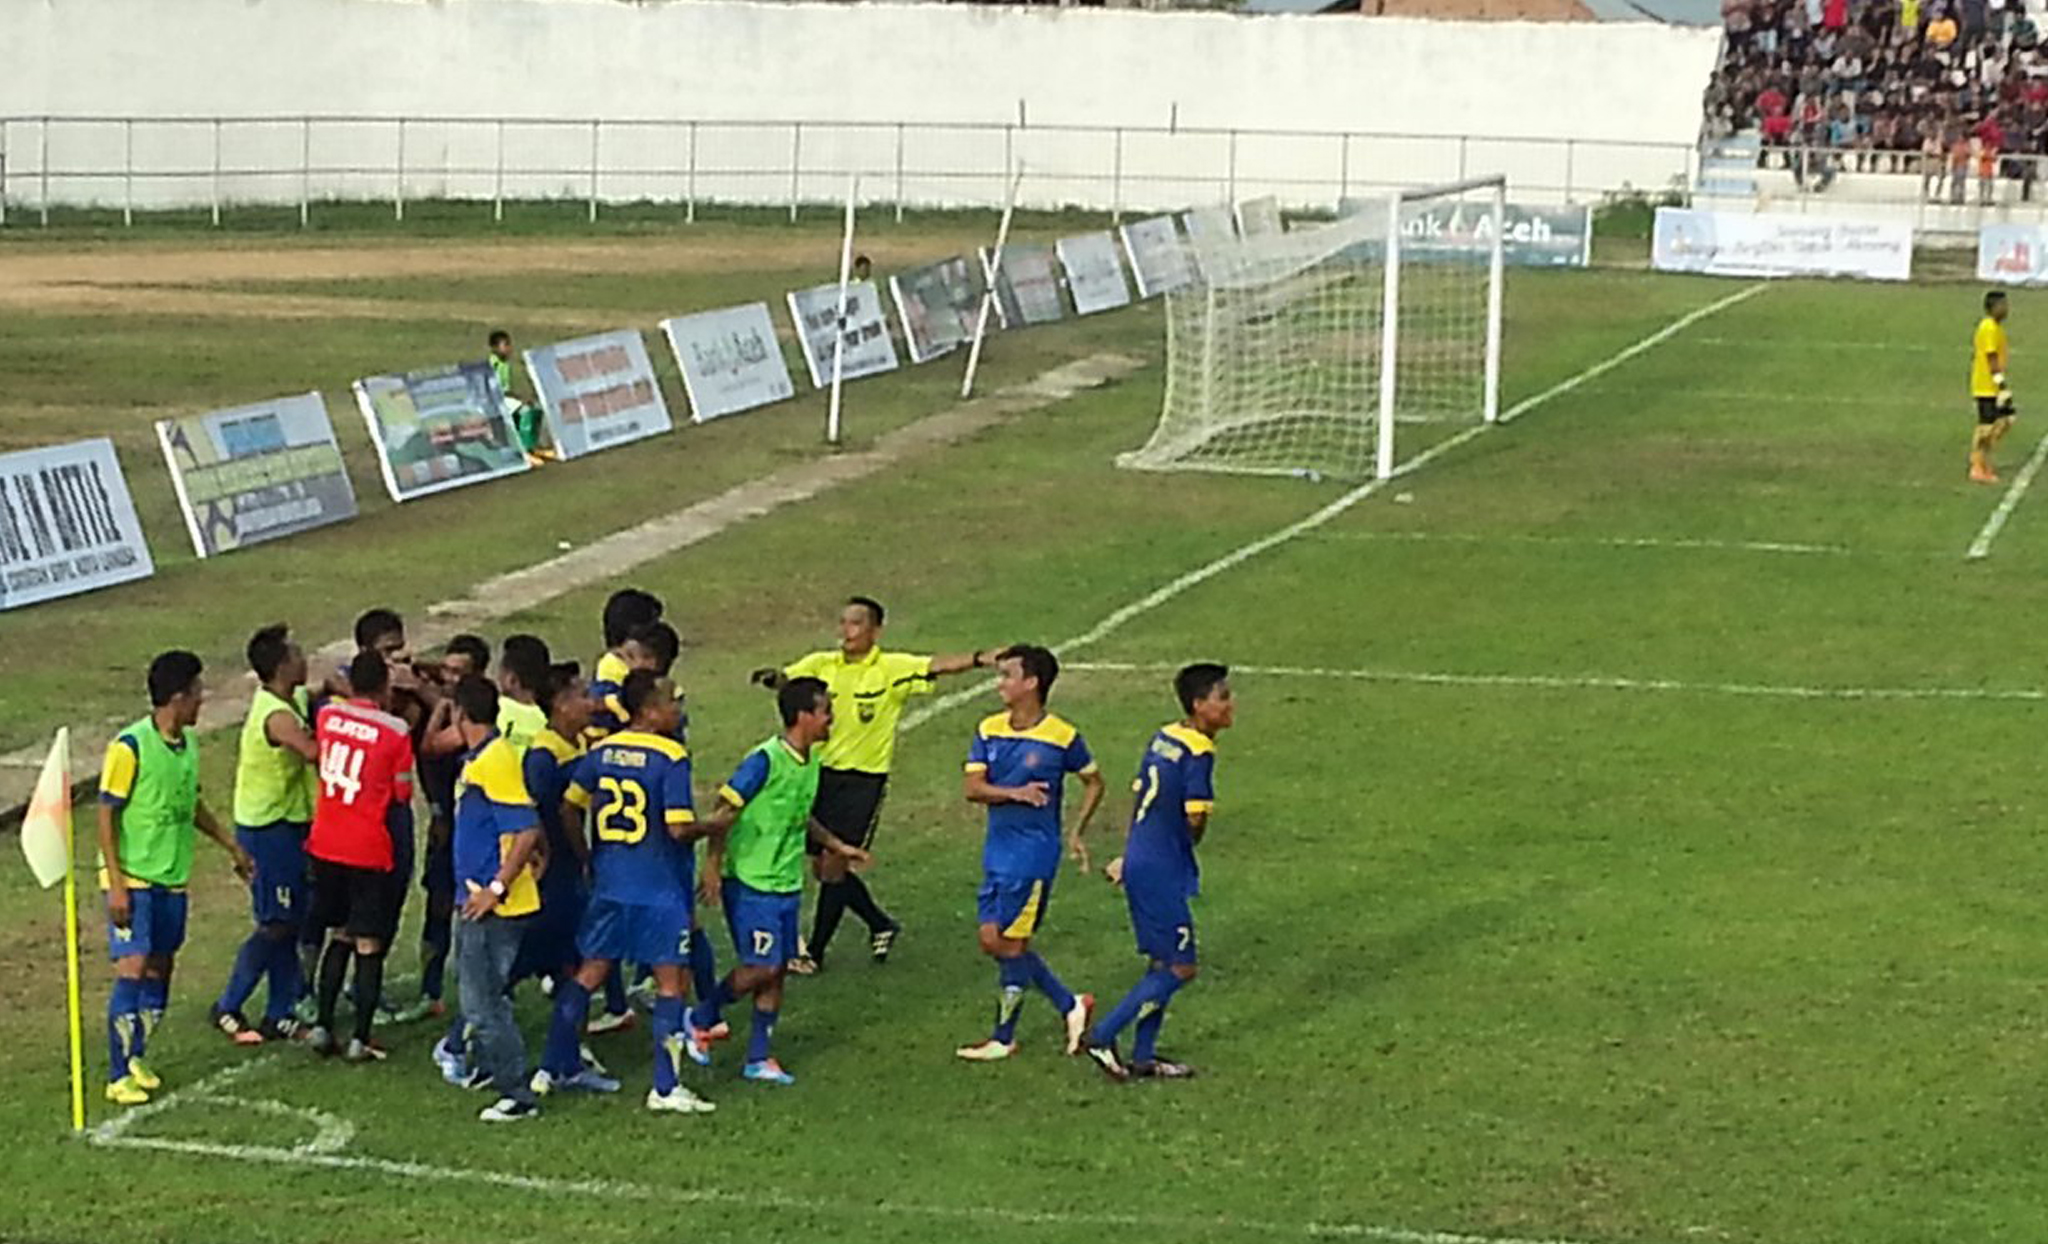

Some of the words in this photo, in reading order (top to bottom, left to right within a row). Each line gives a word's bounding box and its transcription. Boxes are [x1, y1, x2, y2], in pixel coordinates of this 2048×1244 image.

[320, 738, 365, 805] 44
[597, 777, 648, 844] 23
[276, 886, 292, 908] 4
[753, 930, 773, 956] 17
[1176, 926, 1191, 951] 7
